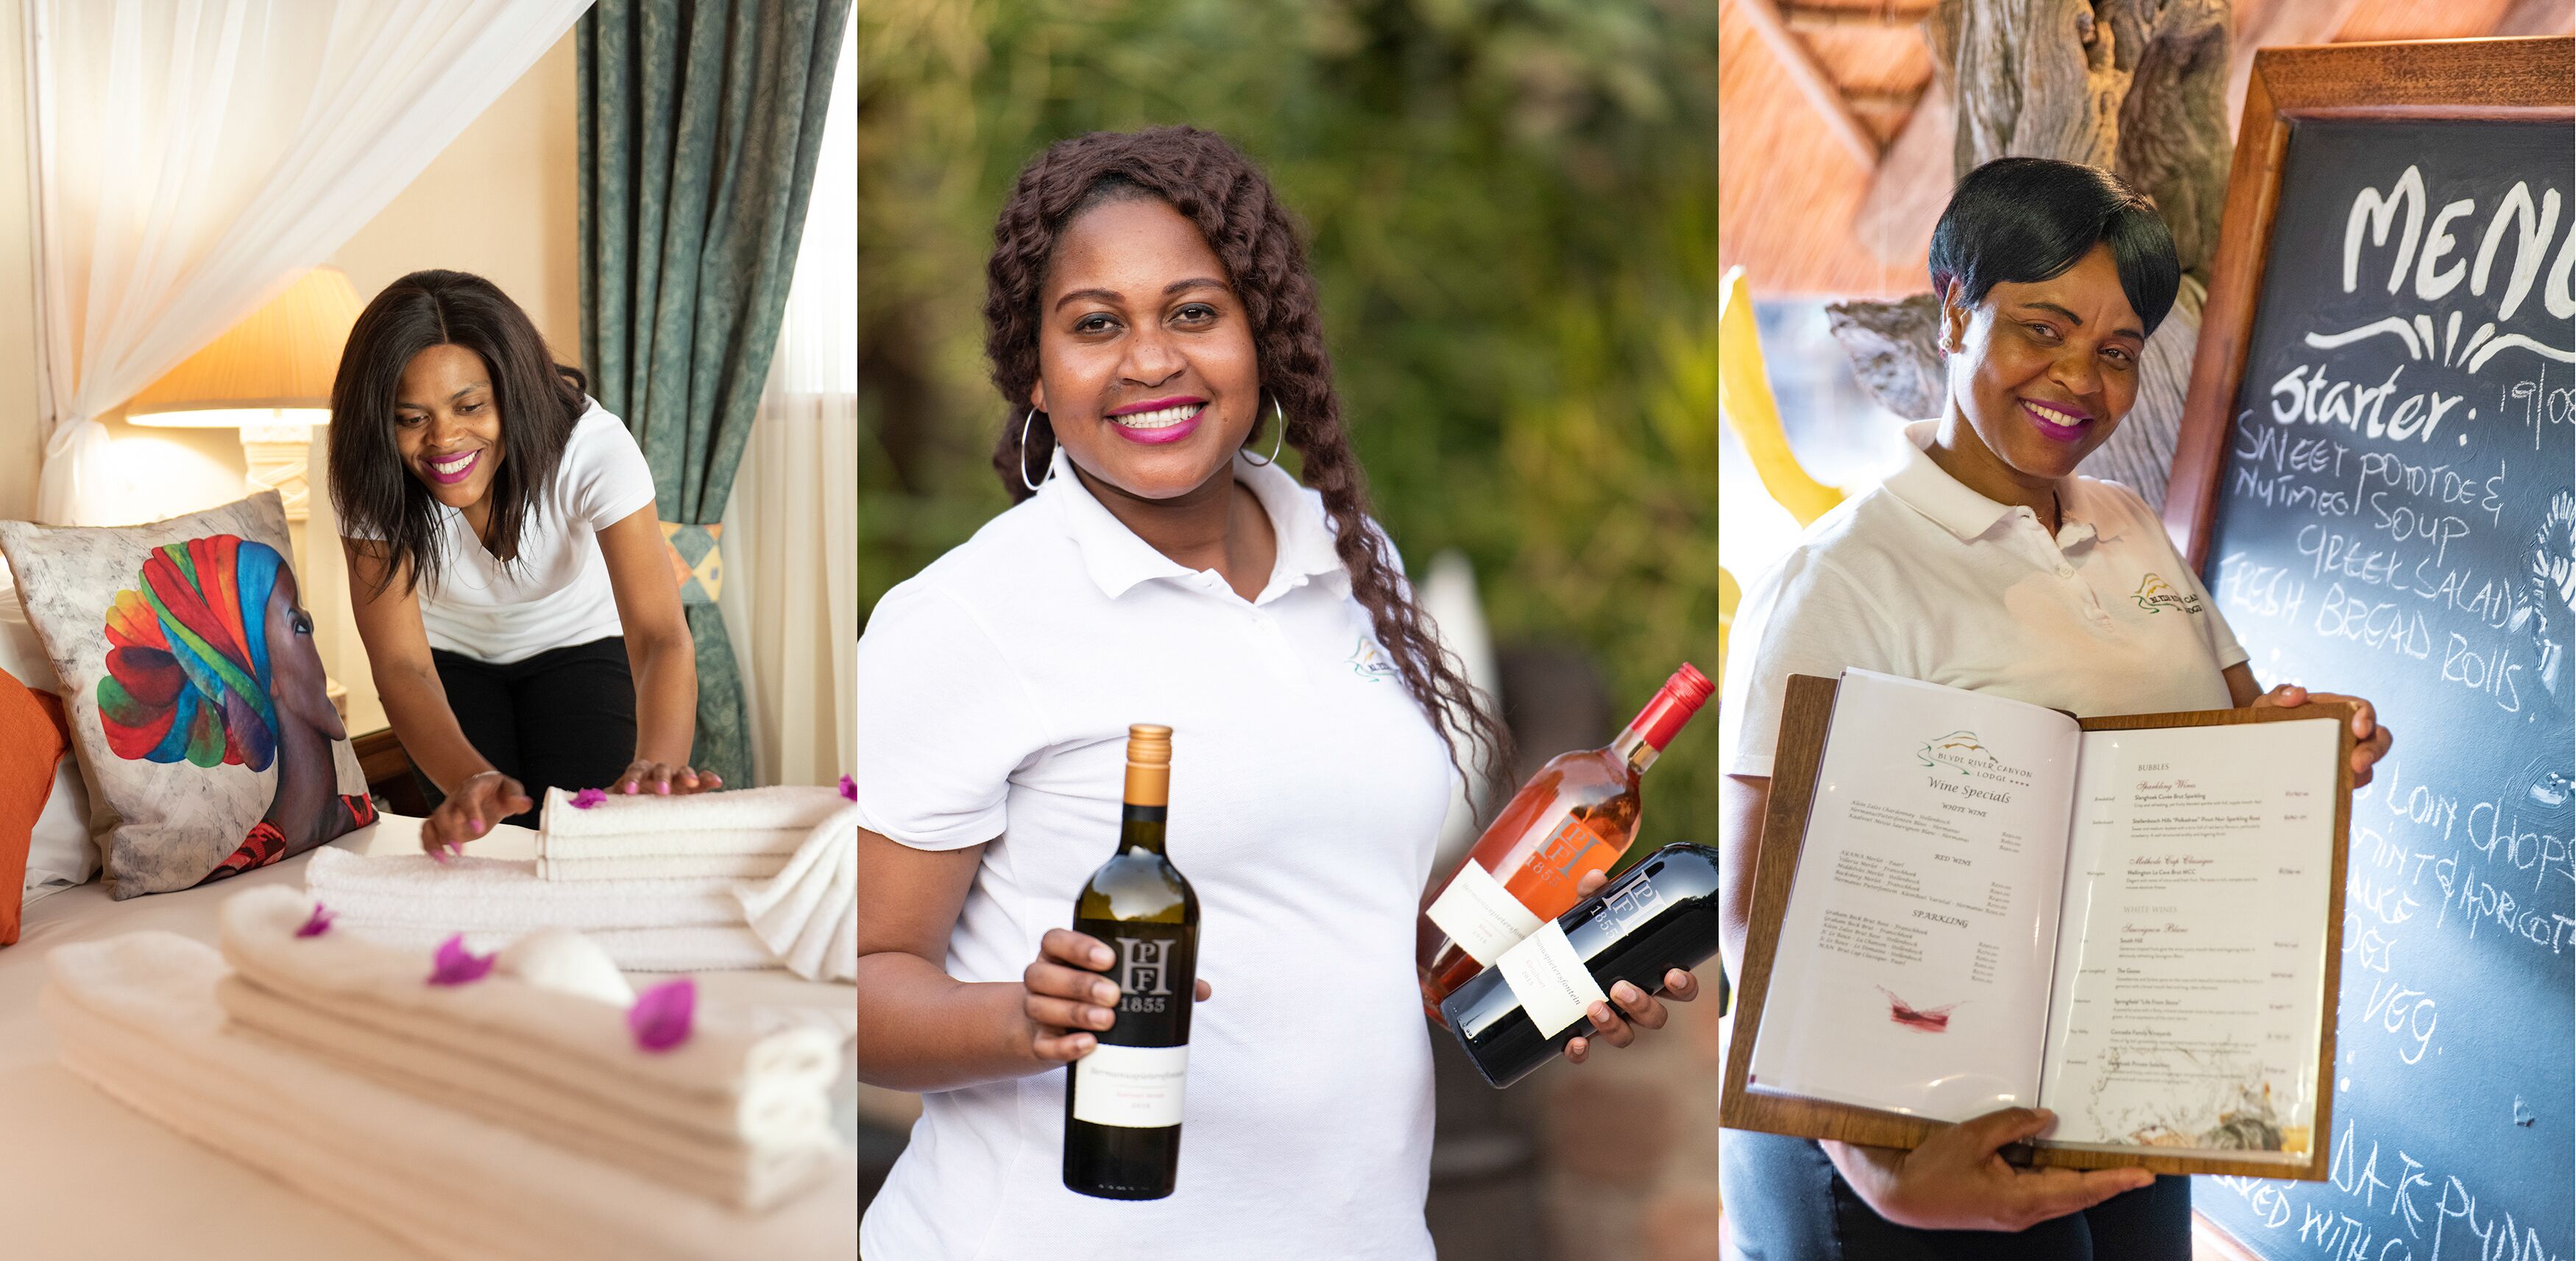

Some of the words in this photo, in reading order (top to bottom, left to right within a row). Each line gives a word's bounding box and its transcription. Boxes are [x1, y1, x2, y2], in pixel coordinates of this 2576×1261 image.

[2271, 364, 2477, 446] Starter:
[2235, 409, 2350, 477] SWEET
[2371, 491, 2471, 568] SOUP
[2297, 524, 2409, 590] GREEK
[2413, 554, 2513, 629] SALAD
[2315, 582, 2431, 660] BREAD
[1967, 758, 1995, 771] RIVER
[1996, 764, 2033, 779] CANYON
[1976, 771, 2006, 783] LODGE
[2137, 763, 2170, 771] BUBBLES
[1927, 776, 1959, 793] Wine
[1963, 785, 2011, 805] Specials
[2136, 780, 2173, 791] Sparkling
[2174, 779, 2197, 790] Wines
[1942, 802, 1966, 813] WHITE
[1967, 807, 1989, 818] WINE
[1934, 853, 1950, 862] RED
[1951, 856, 1973, 867] WINE
[1911, 909, 1970, 929] SPARKLING
[2151, 905, 2178, 914] WINES
[1590, 905, 1620, 939] 1855
[1120, 996, 1166, 1014] 1855
